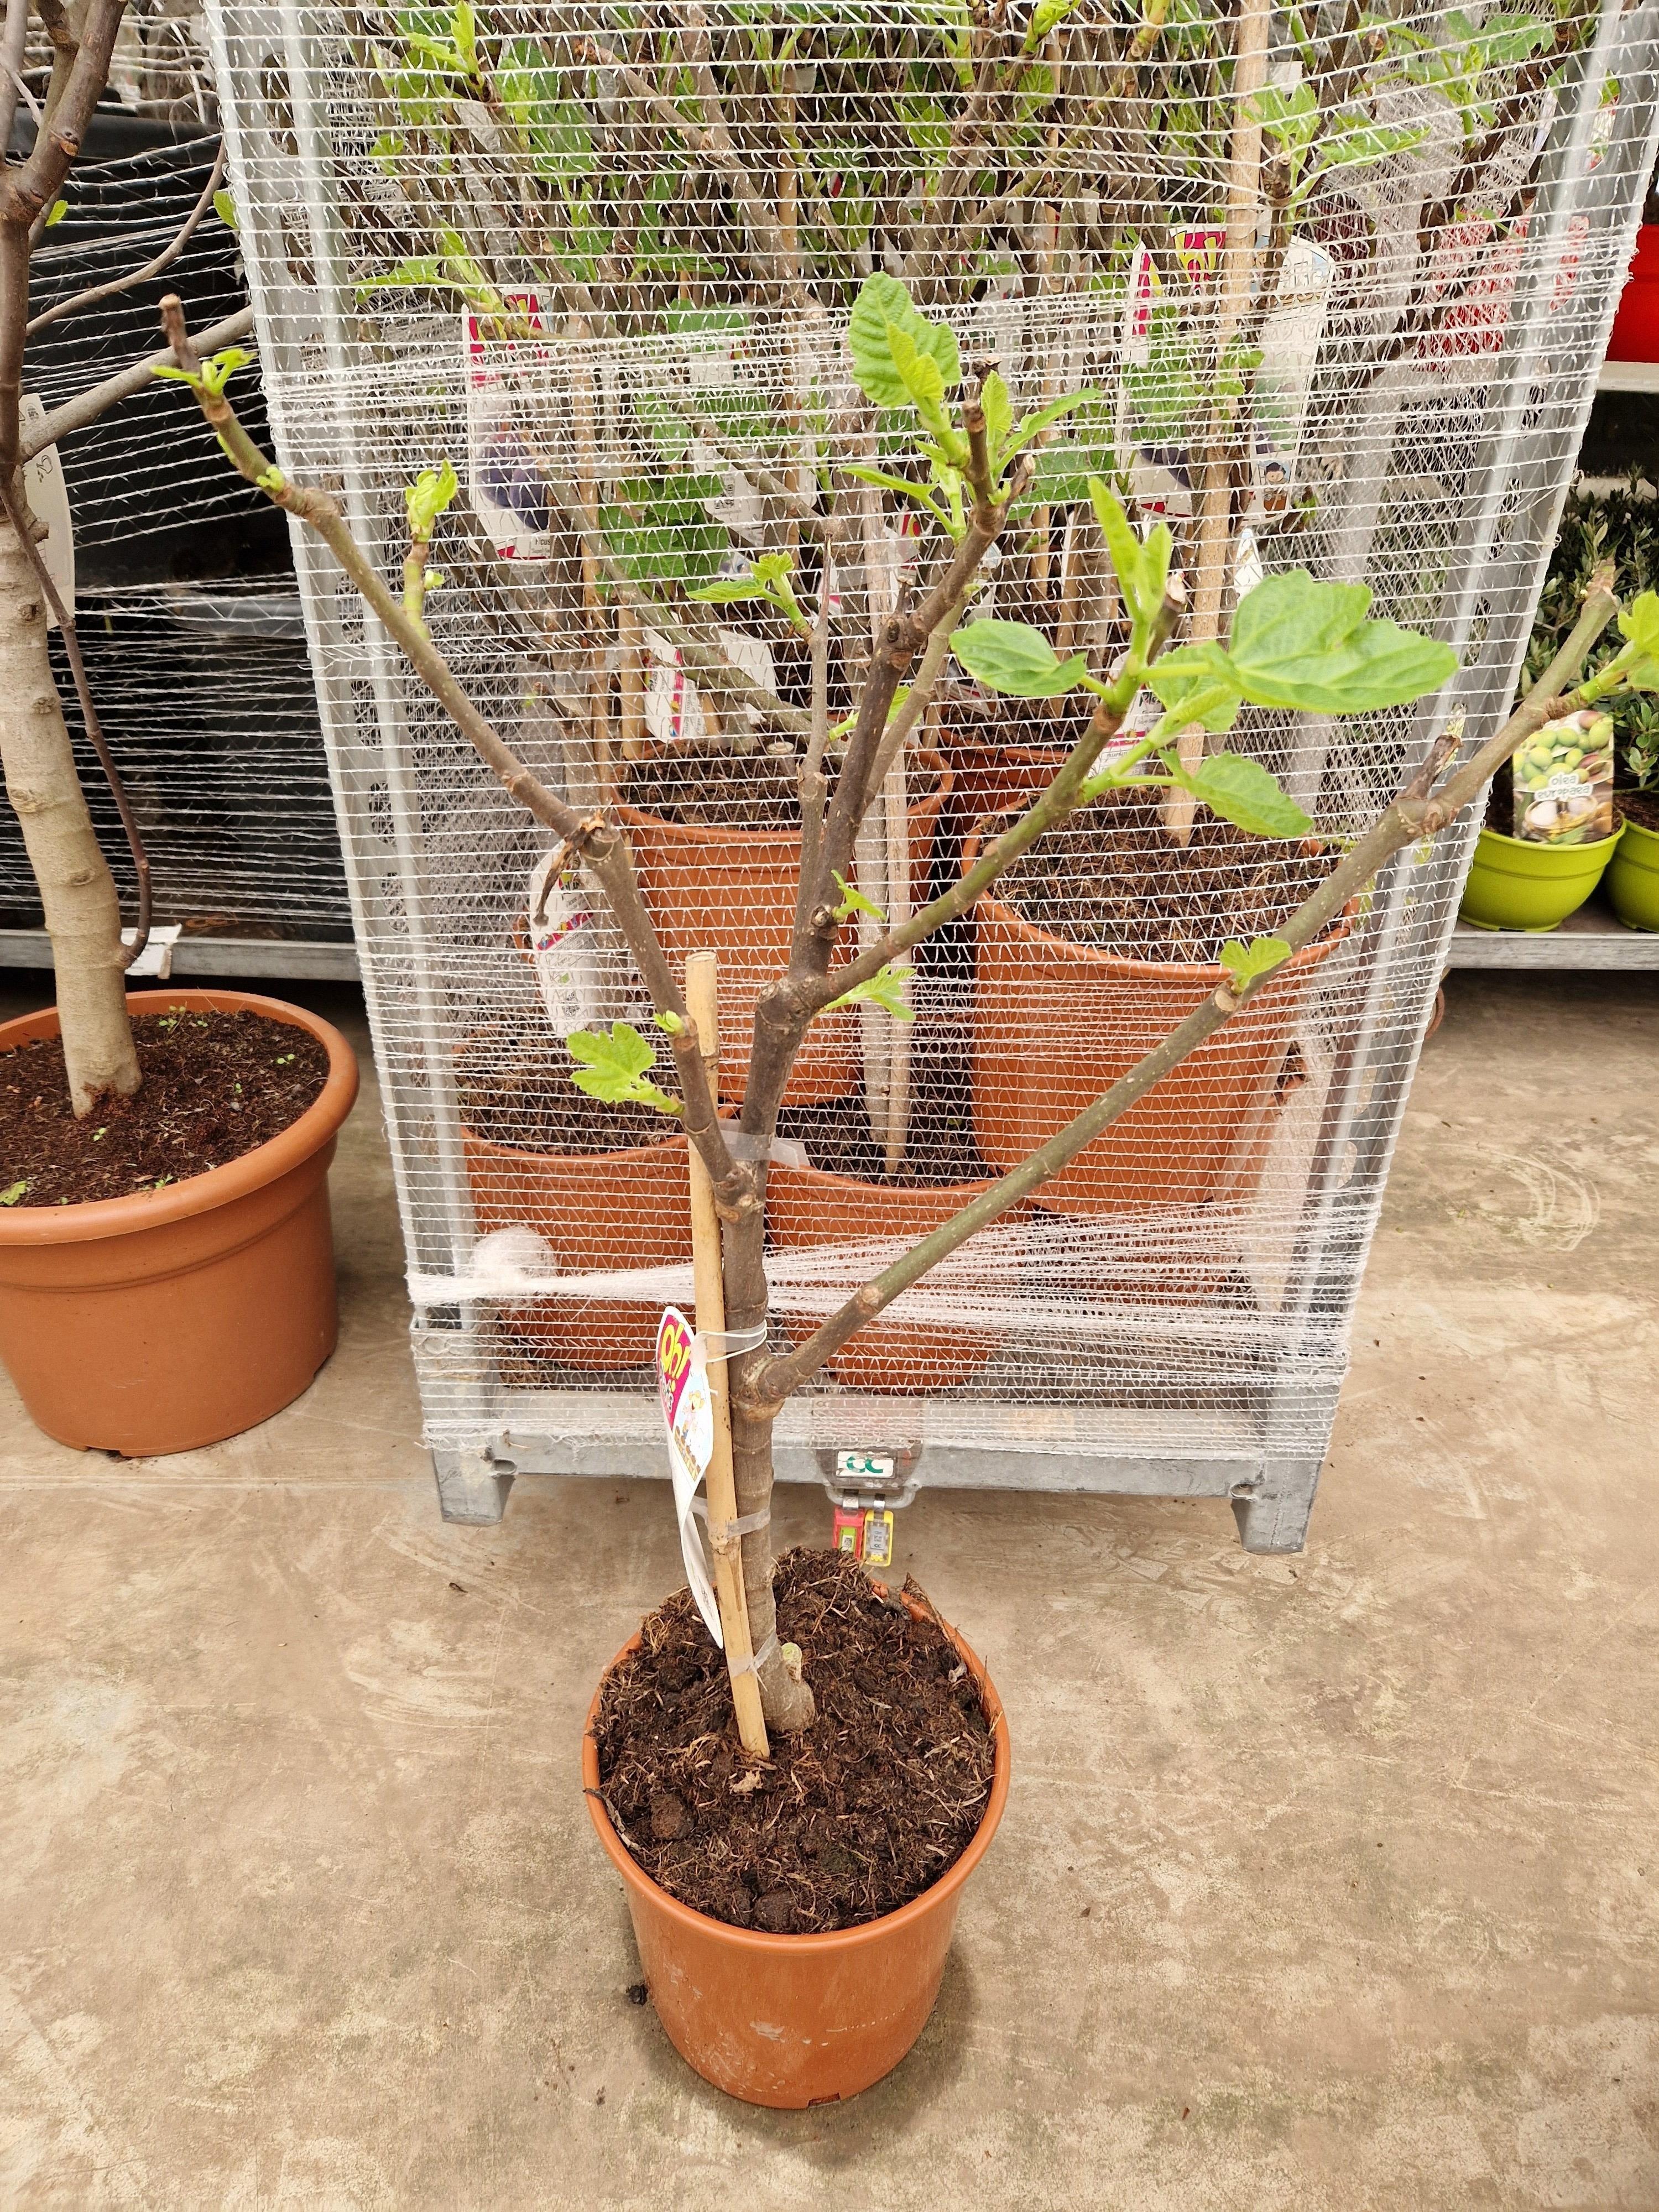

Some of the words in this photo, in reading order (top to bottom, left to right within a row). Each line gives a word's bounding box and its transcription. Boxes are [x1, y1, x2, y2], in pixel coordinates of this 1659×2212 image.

[1552, 774, 1576, 785] olea
[1537, 785, 1590, 799] europaea
[661, 1322, 691, 1392] Oh!
